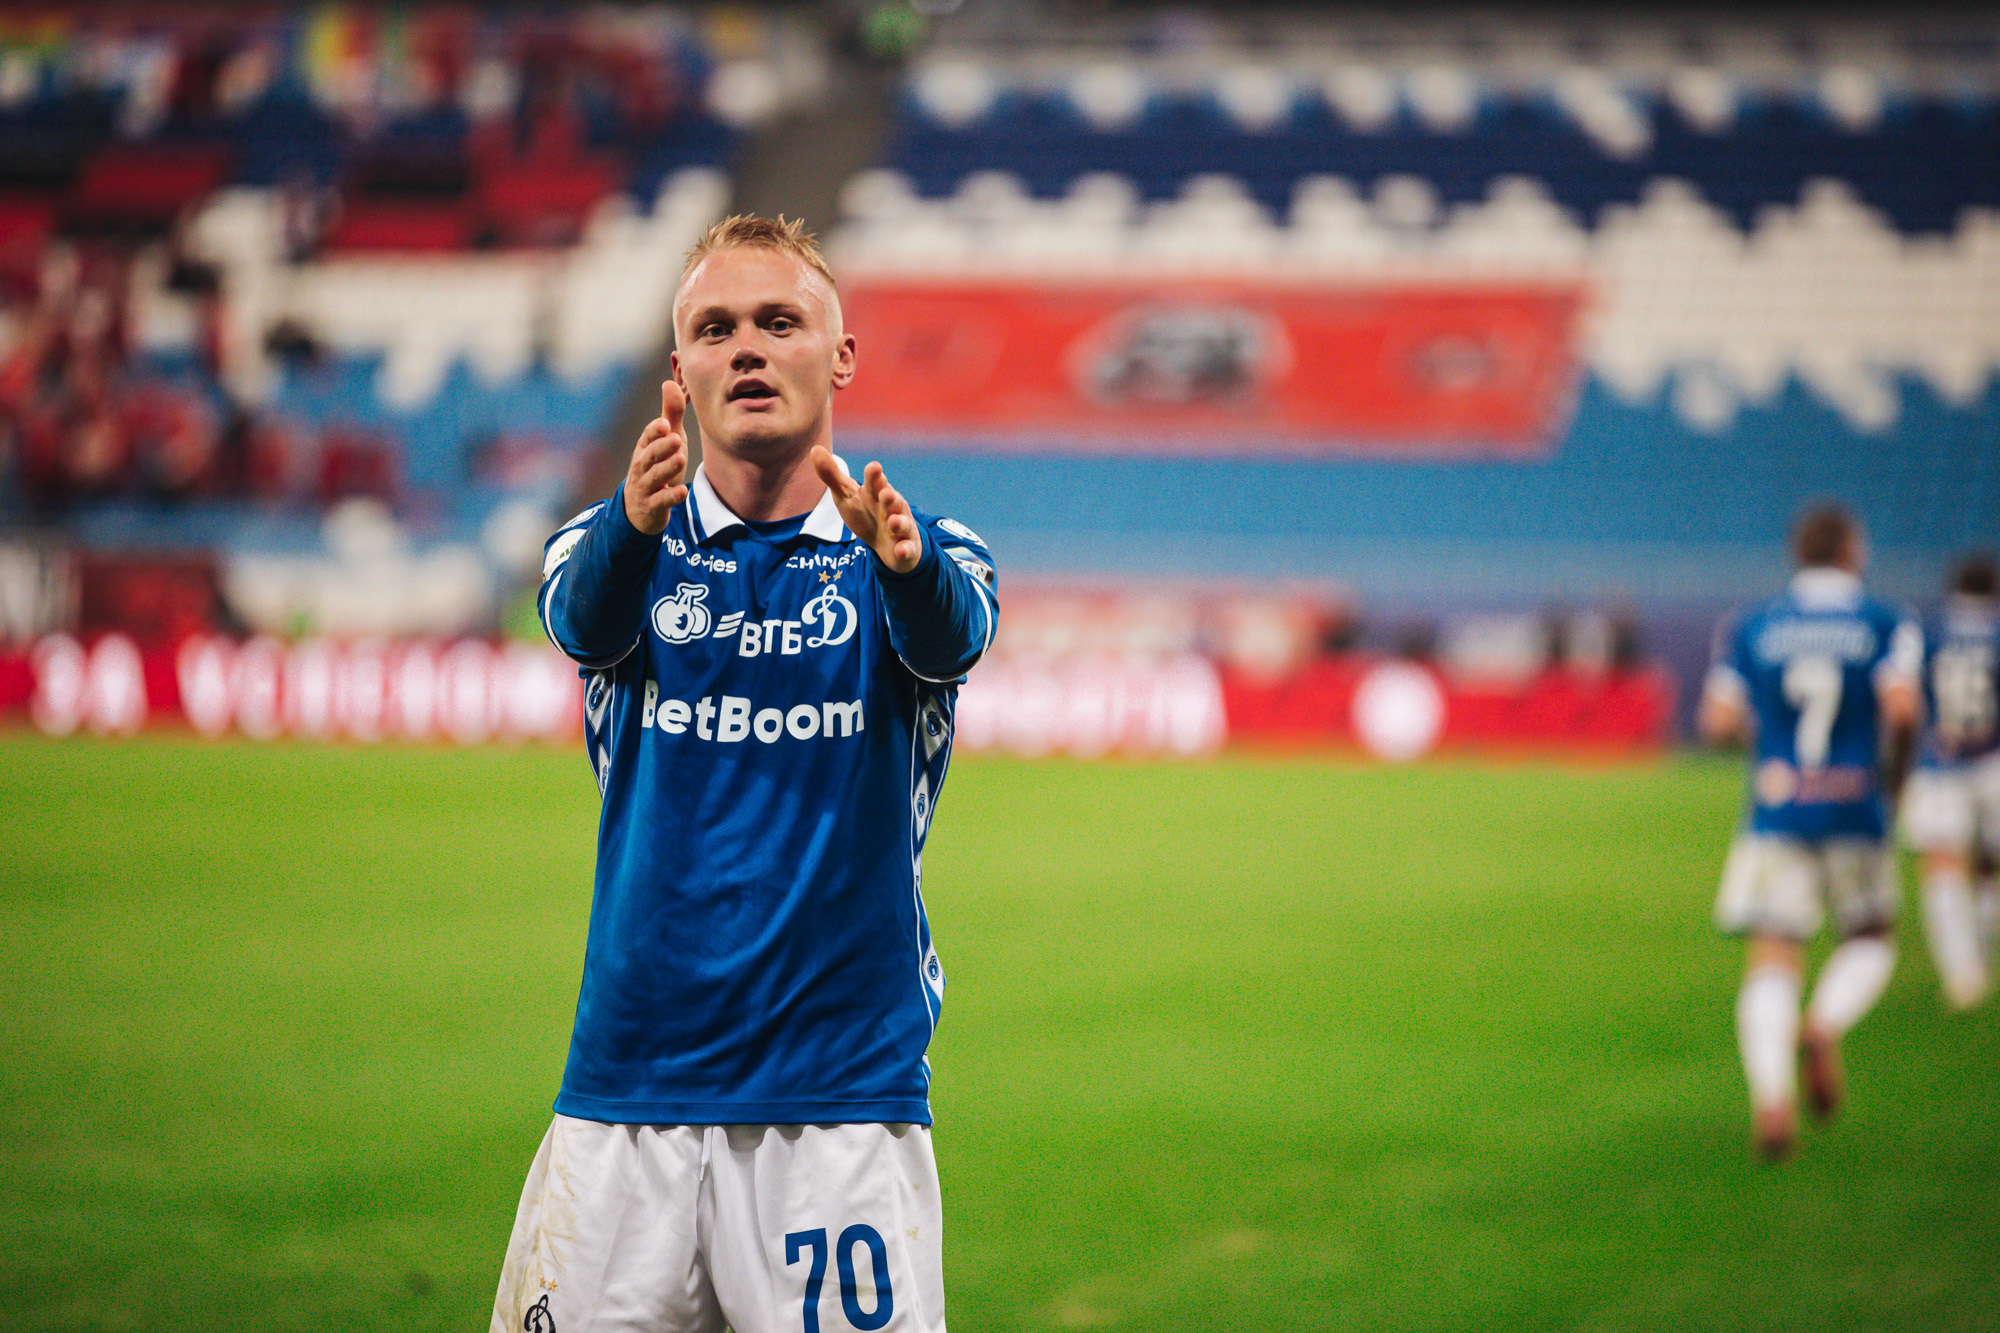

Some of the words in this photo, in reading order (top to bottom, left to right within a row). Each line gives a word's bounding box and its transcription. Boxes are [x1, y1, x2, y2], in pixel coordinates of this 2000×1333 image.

[738, 619, 803, 658] ВТБ
[641, 679, 865, 743] BetBoom
[1782, 655, 1843, 772] 7
[784, 1223, 894, 1333] 70
